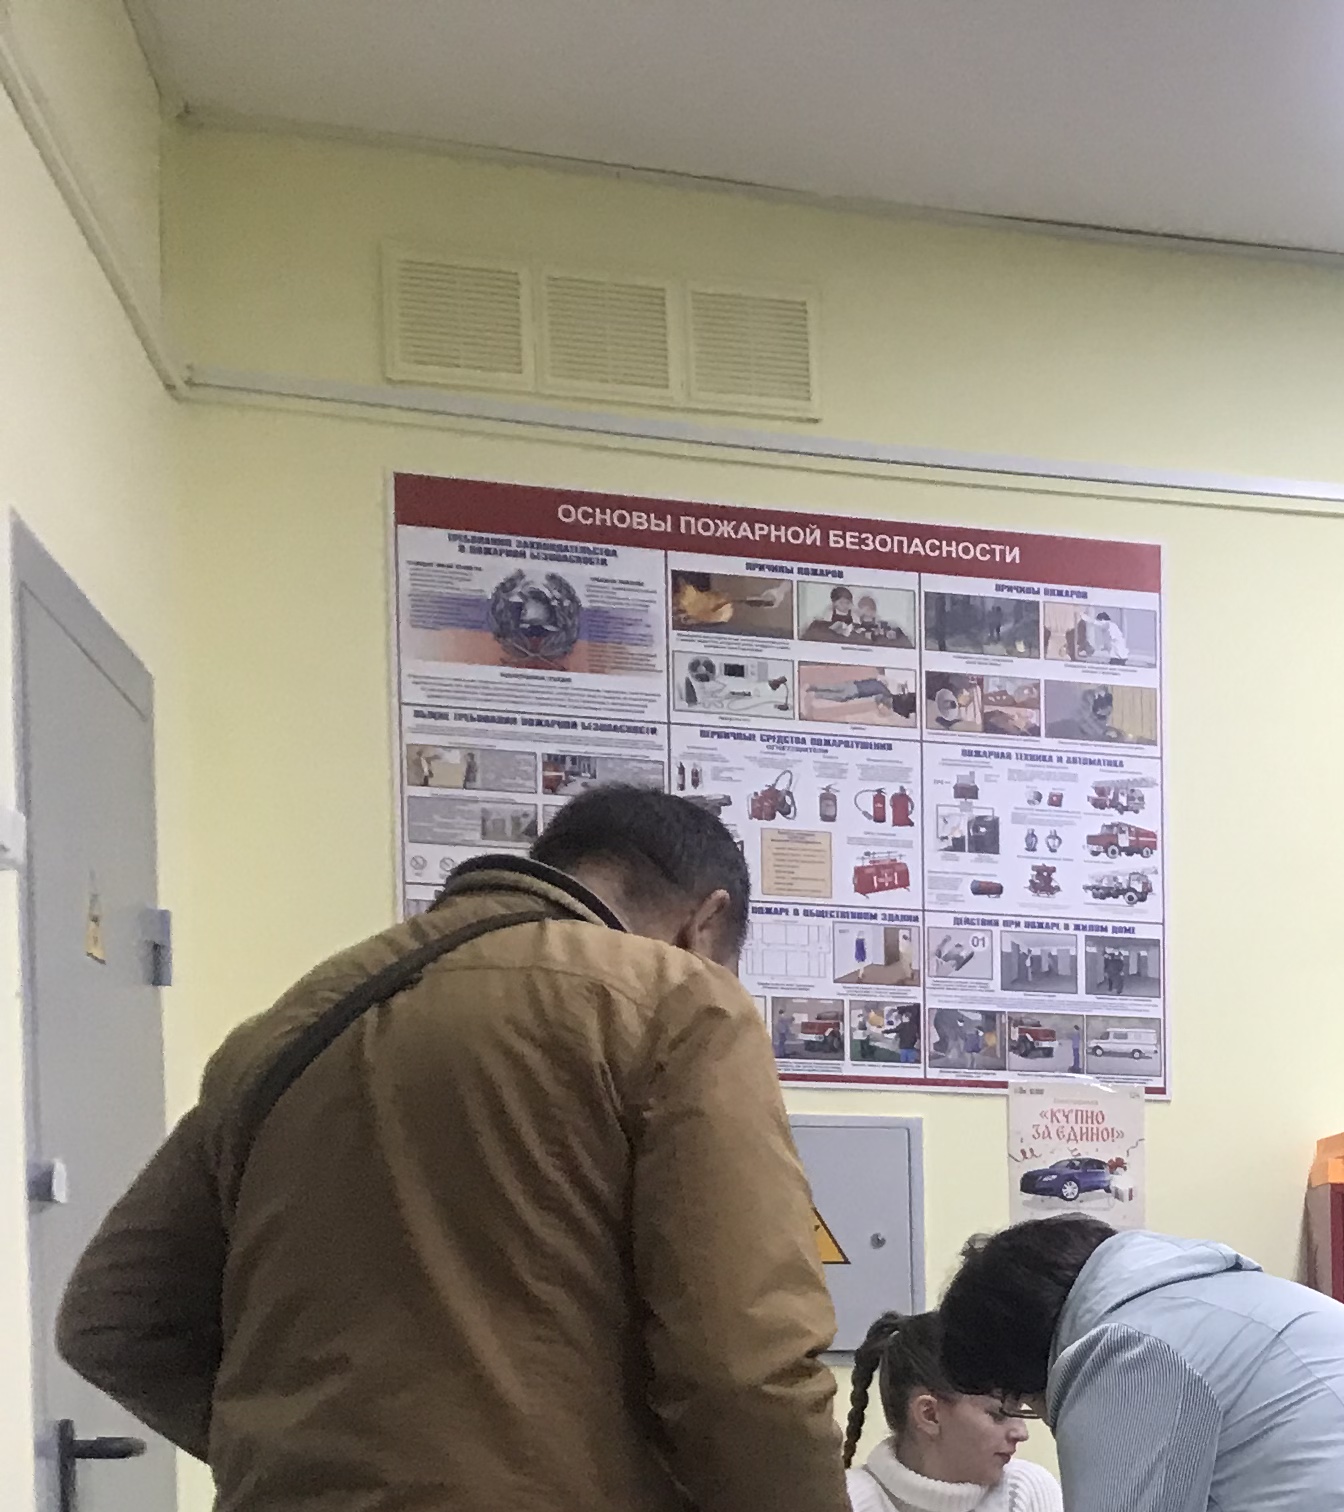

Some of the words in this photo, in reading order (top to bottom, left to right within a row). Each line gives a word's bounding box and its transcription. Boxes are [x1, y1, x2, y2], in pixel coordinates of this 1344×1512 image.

[557, 503, 671, 532] ОСНОВЫ
[680, 514, 821, 547] ПОЖАРНОЙ
[829, 529, 1021, 564] БЕЗОПАСНОСТИ
[970, 934, 987, 949] 01
